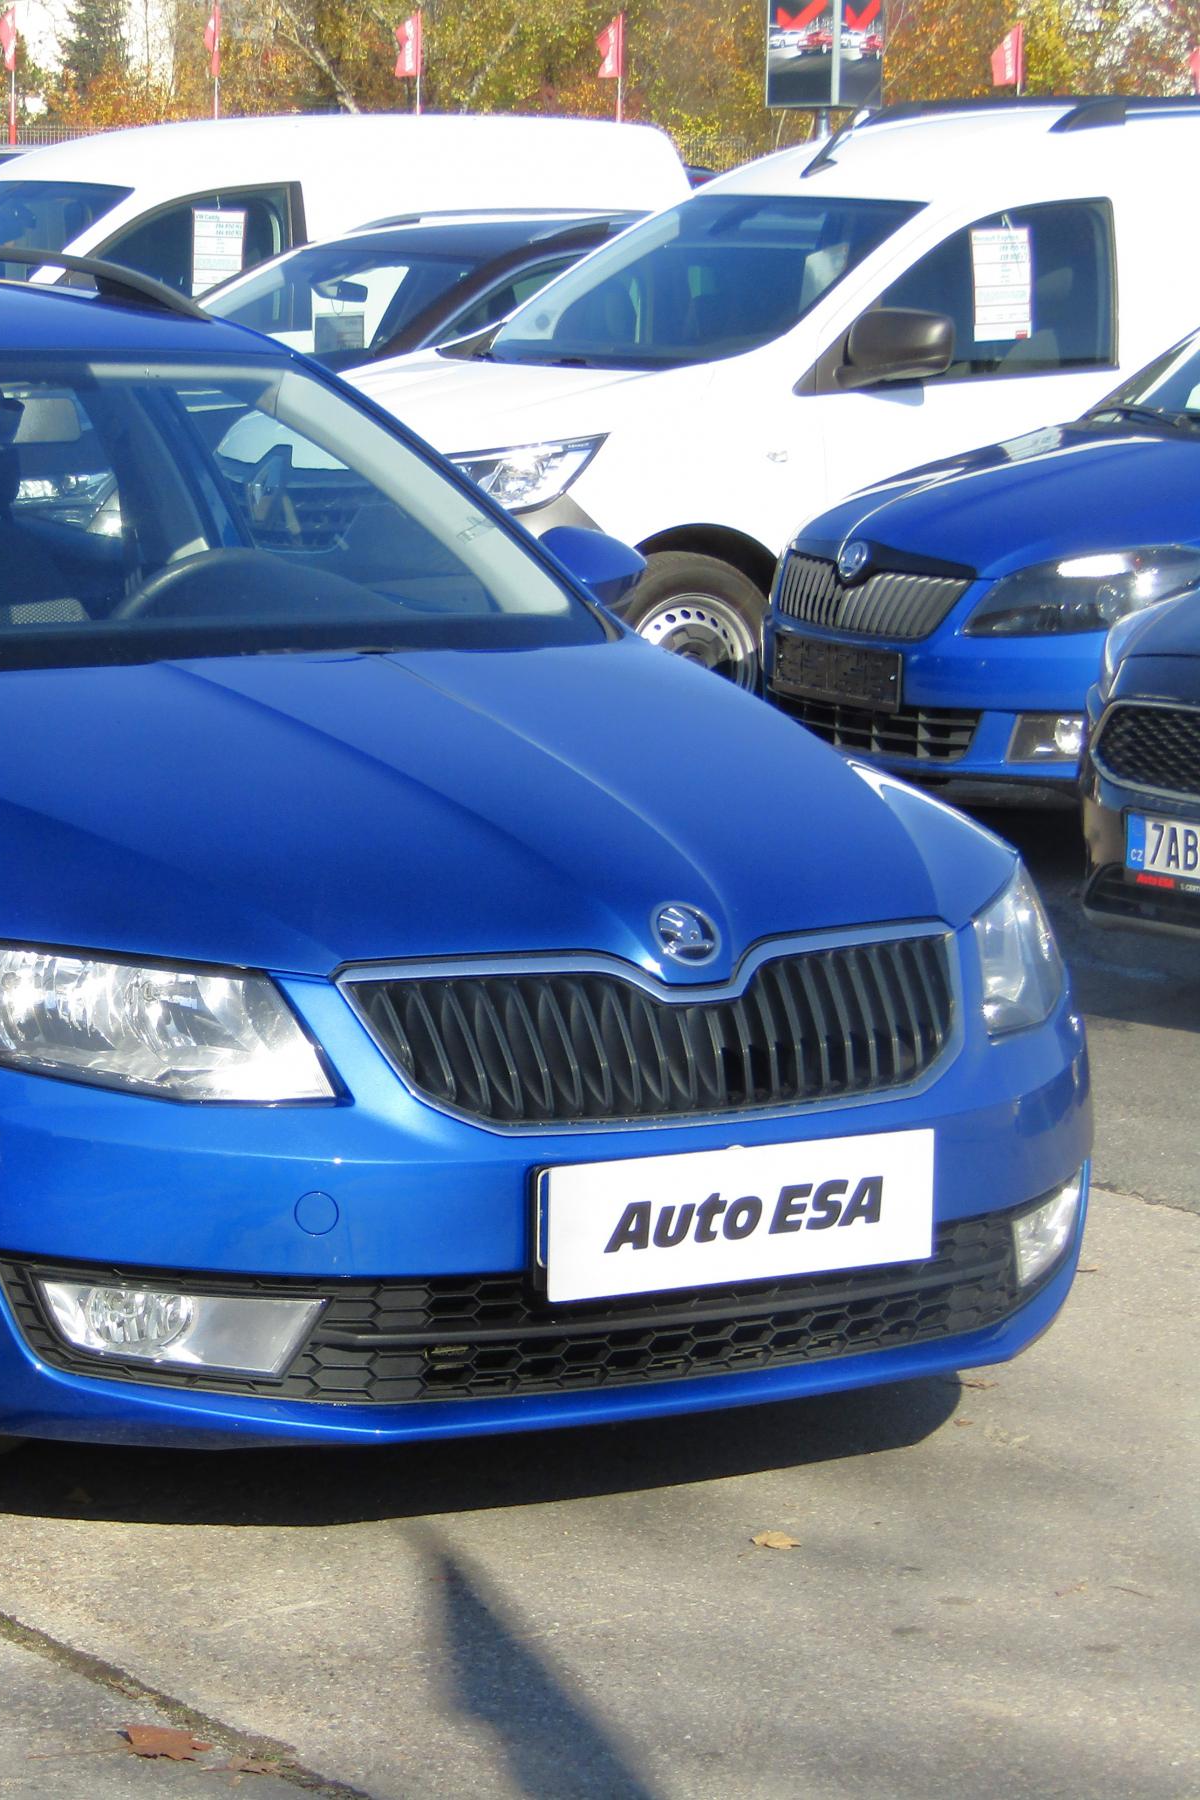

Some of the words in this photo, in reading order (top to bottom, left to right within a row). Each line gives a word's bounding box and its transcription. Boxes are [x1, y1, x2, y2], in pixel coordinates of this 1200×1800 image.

[1130, 848, 1143, 862] CZ
[1150, 823, 1199, 871] 7AB
[604, 1192, 762, 1253] Auto
[768, 1175, 883, 1235] ESA
